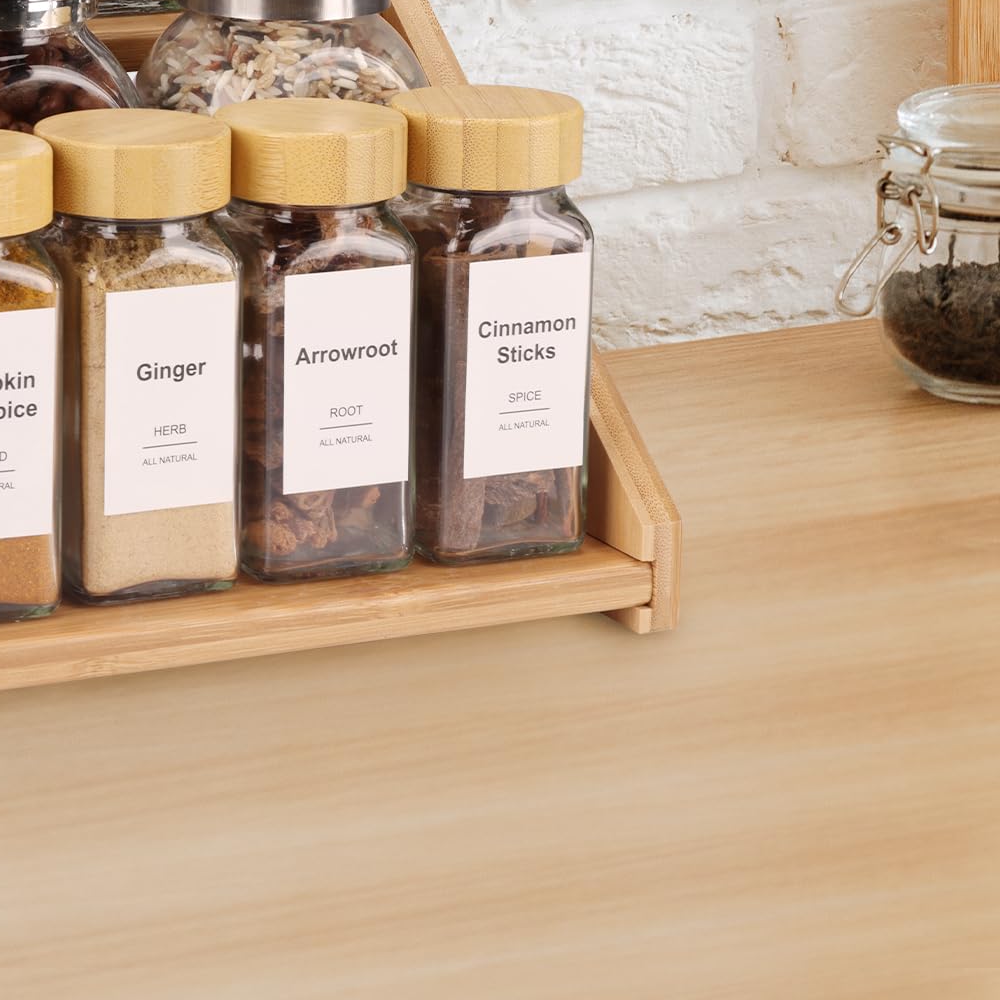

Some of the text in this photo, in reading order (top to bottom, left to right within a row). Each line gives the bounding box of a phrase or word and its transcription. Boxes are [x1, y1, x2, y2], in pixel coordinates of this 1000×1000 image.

[478, 316, 577, 339] Cinnamon
[294, 338, 399, 366] Arrowroot
[496, 343, 556, 365] Sticks
[136, 361, 207, 383] Ginger
[507, 389, 543, 404] SPICE
[329, 404, 364, 419] ROOT
[153, 423, 187, 437] HERB
[498, 418, 550, 432] ALL NATURAL
[319, 434, 373, 448] ALL NATURAL
[141, 452, 198, 467] ALL NATURAL
